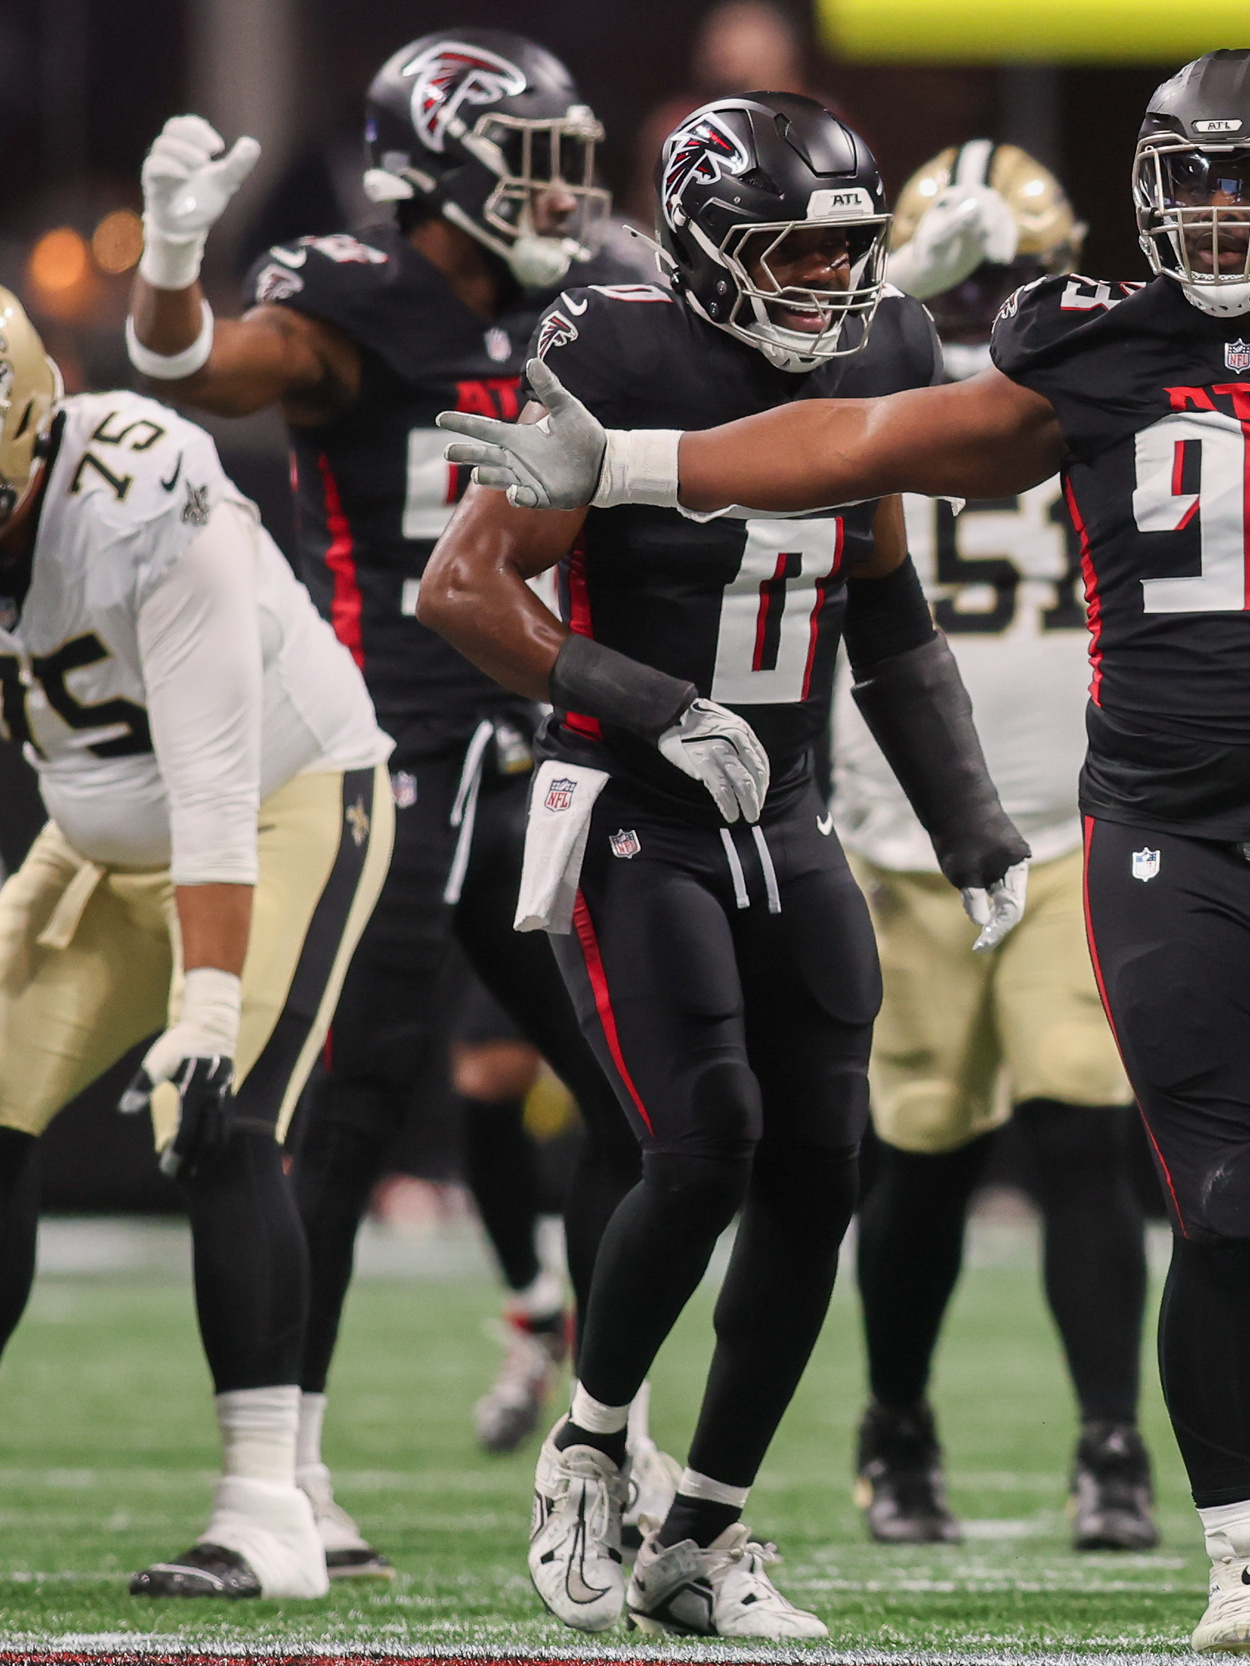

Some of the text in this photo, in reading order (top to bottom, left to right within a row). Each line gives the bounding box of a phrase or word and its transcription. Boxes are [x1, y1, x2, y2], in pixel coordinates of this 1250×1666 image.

[1207, 121, 1231, 130] ATL
[831, 193, 862, 207] ATL
[70, 411, 165, 502] 75
[710, 515, 845, 704] 0
